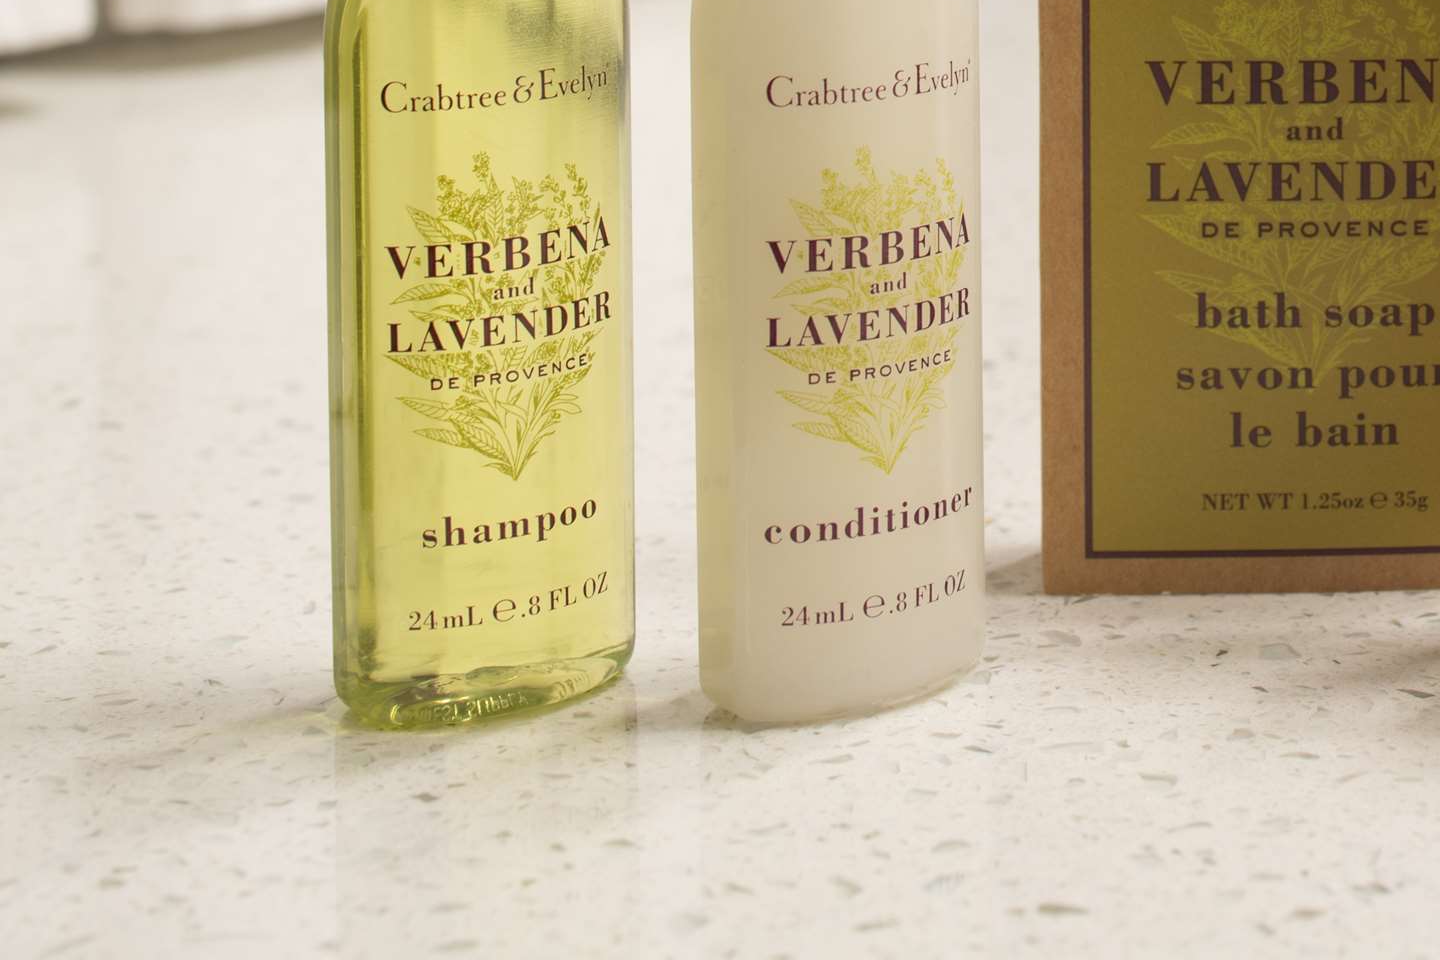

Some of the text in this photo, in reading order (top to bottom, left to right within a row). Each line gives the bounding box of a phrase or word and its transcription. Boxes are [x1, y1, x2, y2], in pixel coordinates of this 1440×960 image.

[1287, 117, 1343, 141] and
[765, 213, 970, 274] VERBENA
[1202, 220, 1428, 238] DE PROVENCE
[384, 215, 611, 280] VERBENA
[493, 277, 535, 301] and
[870, 272, 906, 294] and
[386, 290, 611, 355] LAVENDER
[766, 287, 970, 349] LAVENDER
[1196, 292, 1435, 336] bath soap
[431, 354, 589, 390] DE PROVENCE
[809, 350, 950, 384] DE PROVENCE
[1177, 368, 1313, 390] savon
[1231, 411, 1398, 447] le bain
[765, 487, 971, 544] conditioner
[1203, 493, 1249, 510] NET
[1257, 493, 1293, 509] WT
[1303, 492, 1364, 509] 1.25oz
[1394, 490, 1428, 512] 35g
[423, 500, 596, 548] shampoo
[551, 587, 576, 610] FL
[583, 572, 607, 598] OZ
[916, 584, 938, 606] FL
[945, 570, 964, 595] OZ
